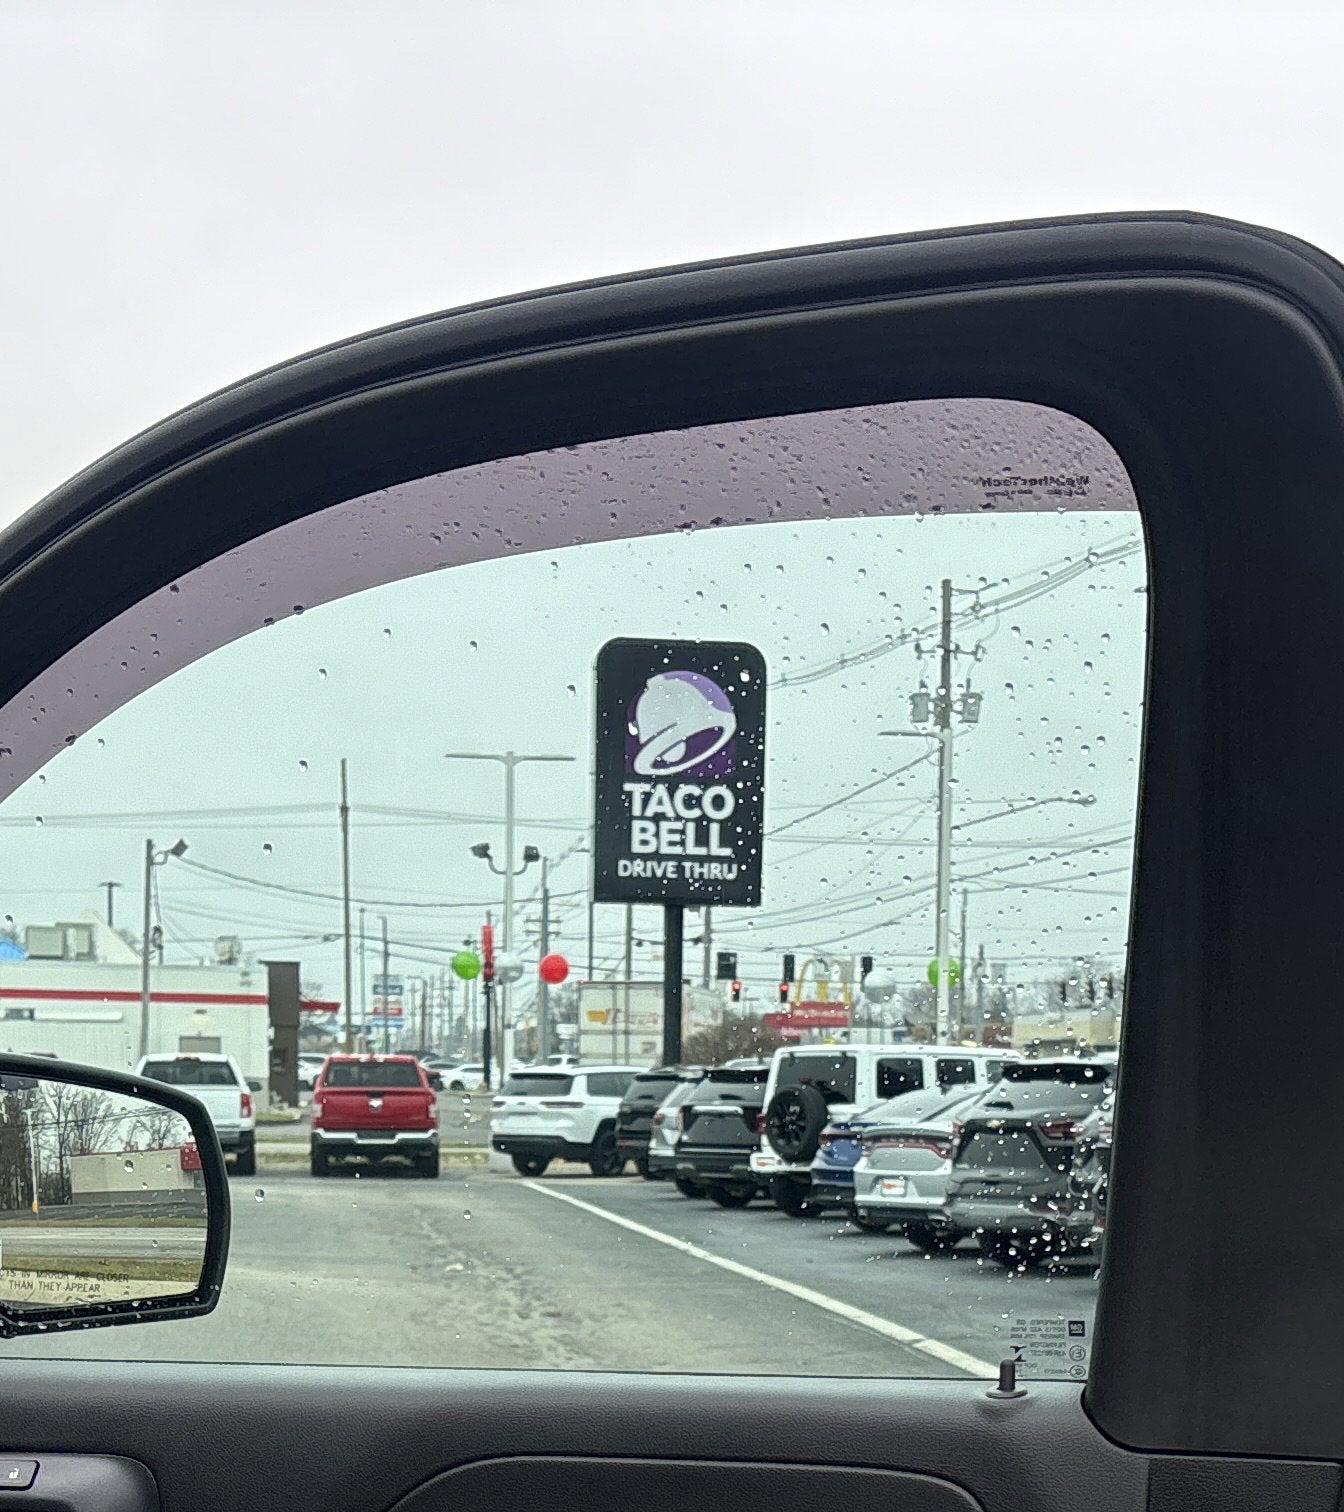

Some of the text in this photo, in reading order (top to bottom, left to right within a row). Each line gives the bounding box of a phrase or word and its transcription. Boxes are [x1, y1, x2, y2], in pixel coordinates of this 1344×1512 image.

[623, 783, 736, 819] TACO
[631, 821, 733, 856] BELL
[618, 859, 738, 880] DRIVE THRU
[9, 1280, 101, 1293] THAN THEY APPEAR
[36, 1271, 70, 1279] MIRROR
[75, 1272, 90, 1281] ARE
[96, 1273, 129, 1283] CLOSER
